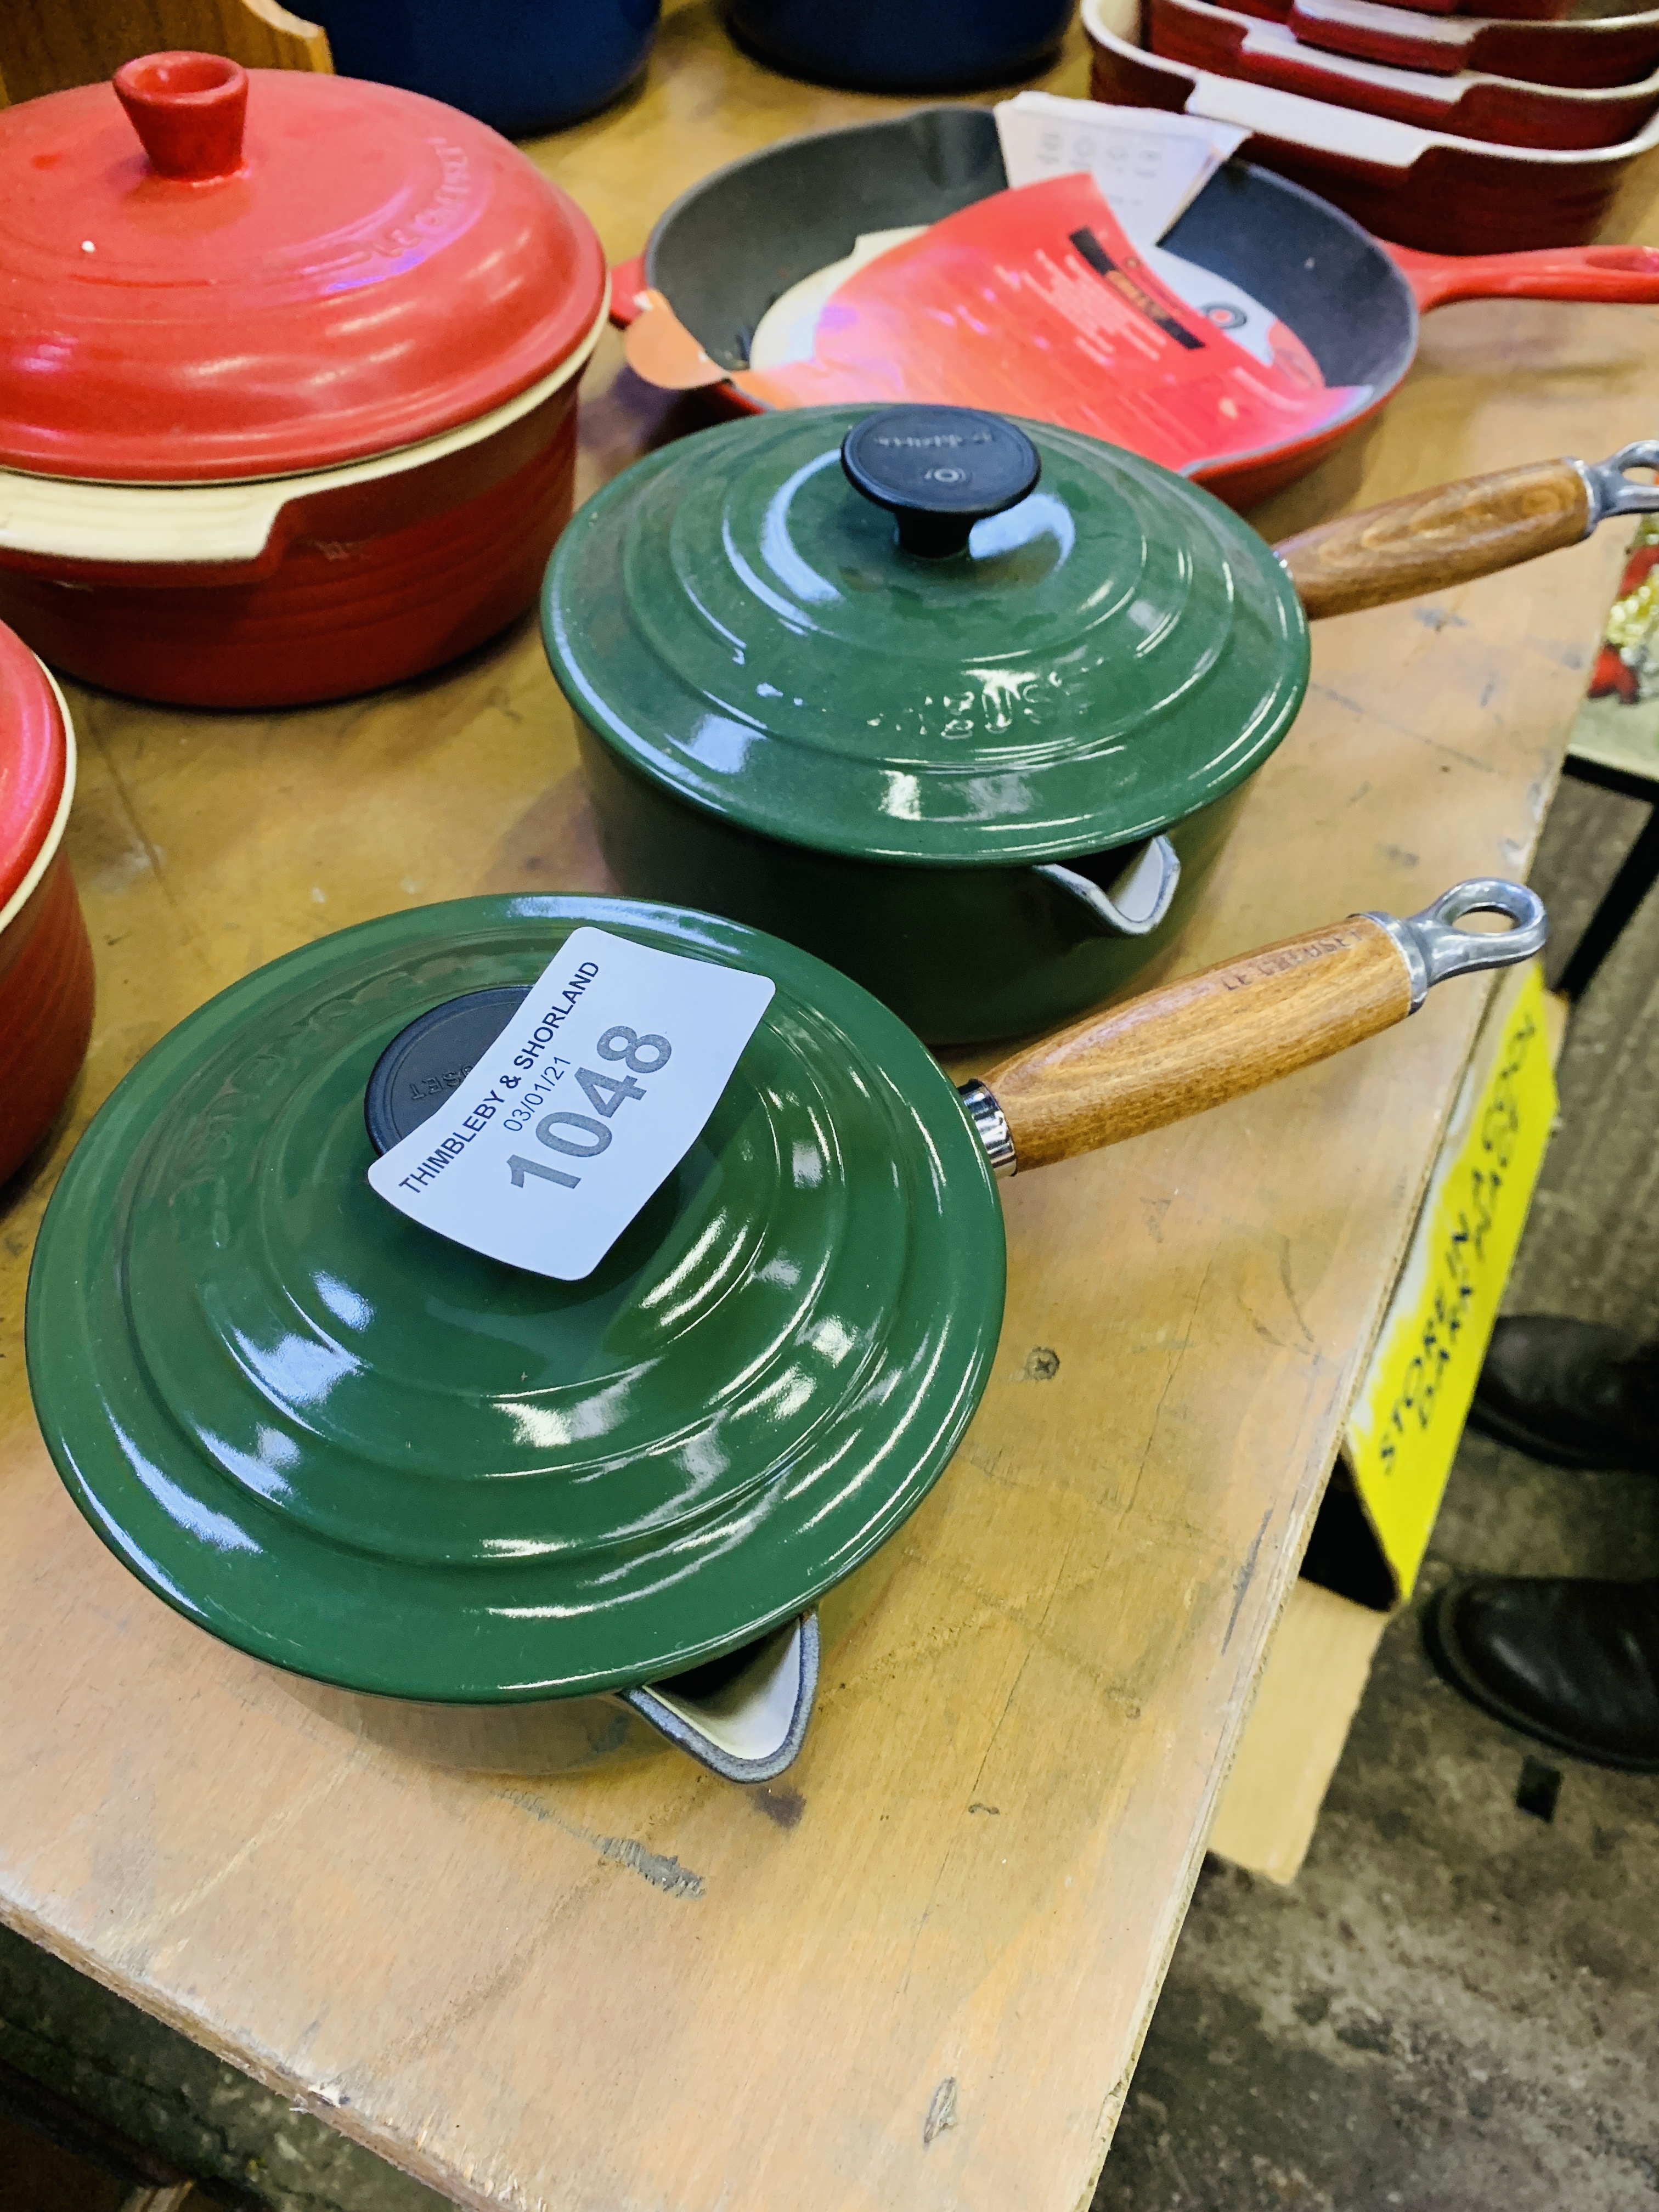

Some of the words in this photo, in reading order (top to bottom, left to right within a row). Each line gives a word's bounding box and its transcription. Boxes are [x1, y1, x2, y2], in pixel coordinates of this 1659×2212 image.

[1222, 972, 1254, 991] LE
[1259, 930, 1363, 976] CREUSET
[398, 1094, 506, 1194] THIMBLEBY
[498, 1075, 523, 1093] &
[516, 961, 600, 1070] SHORLAND
[503, 1056, 572, 1132] 03/01/21
[505, 1024, 673, 1189] 1048
